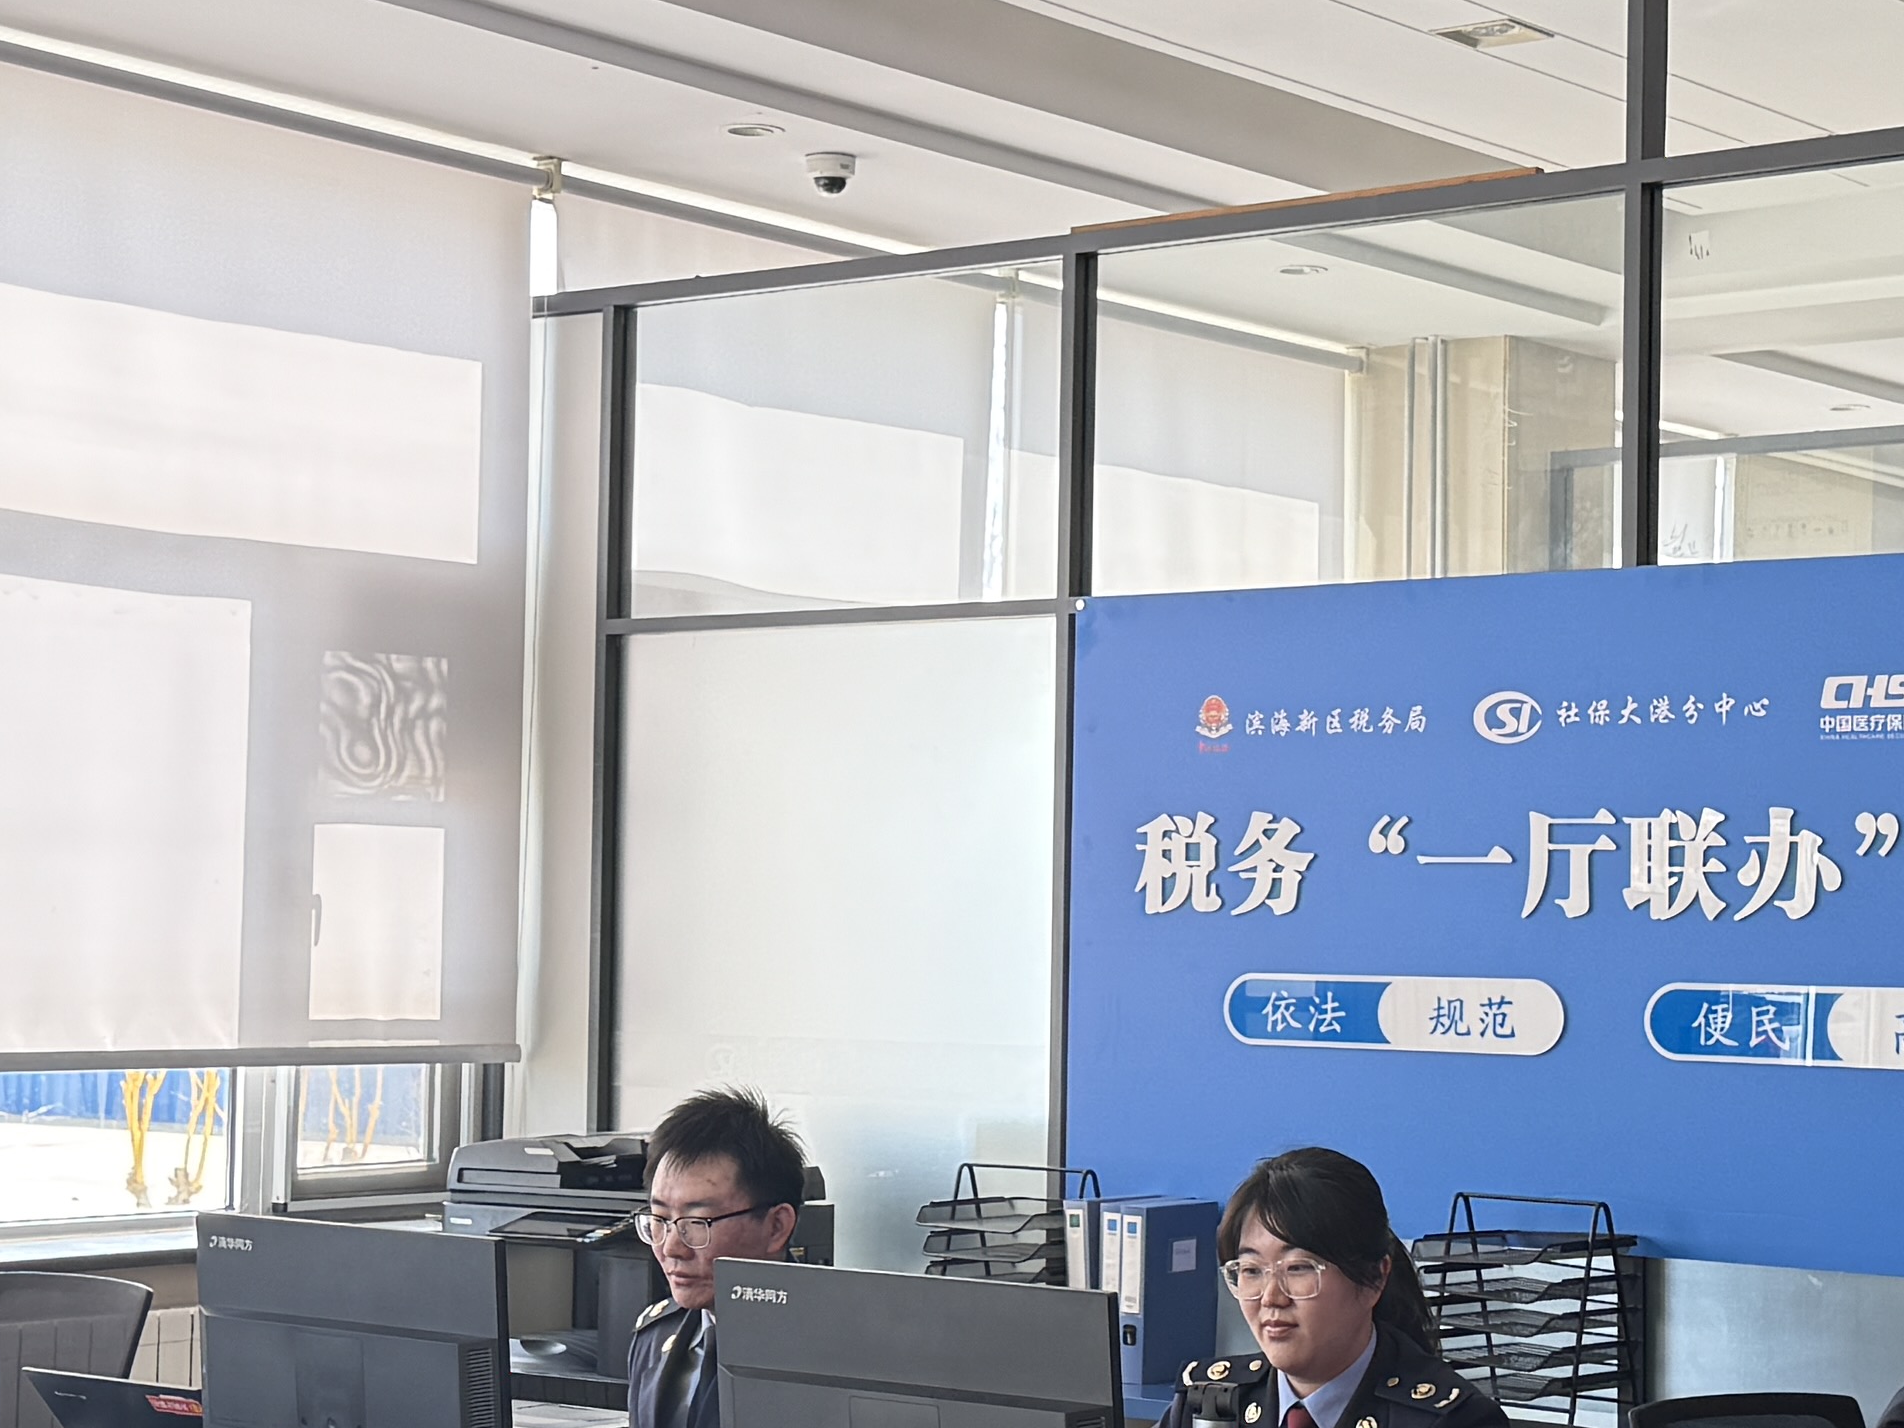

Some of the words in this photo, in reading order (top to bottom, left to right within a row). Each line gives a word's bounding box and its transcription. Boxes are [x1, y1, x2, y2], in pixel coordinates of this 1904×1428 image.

[1245, 704, 1428, 737] 滨海新区税务局
[1556, 692, 1770, 727] 社保大港分中心
[1261, 990, 1346, 1034] 依法
[1427, 995, 1516, 1039] 规范
[1691, 1001, 1791, 1051] 便民
[742, 1287, 788, 1304] 清华同方
